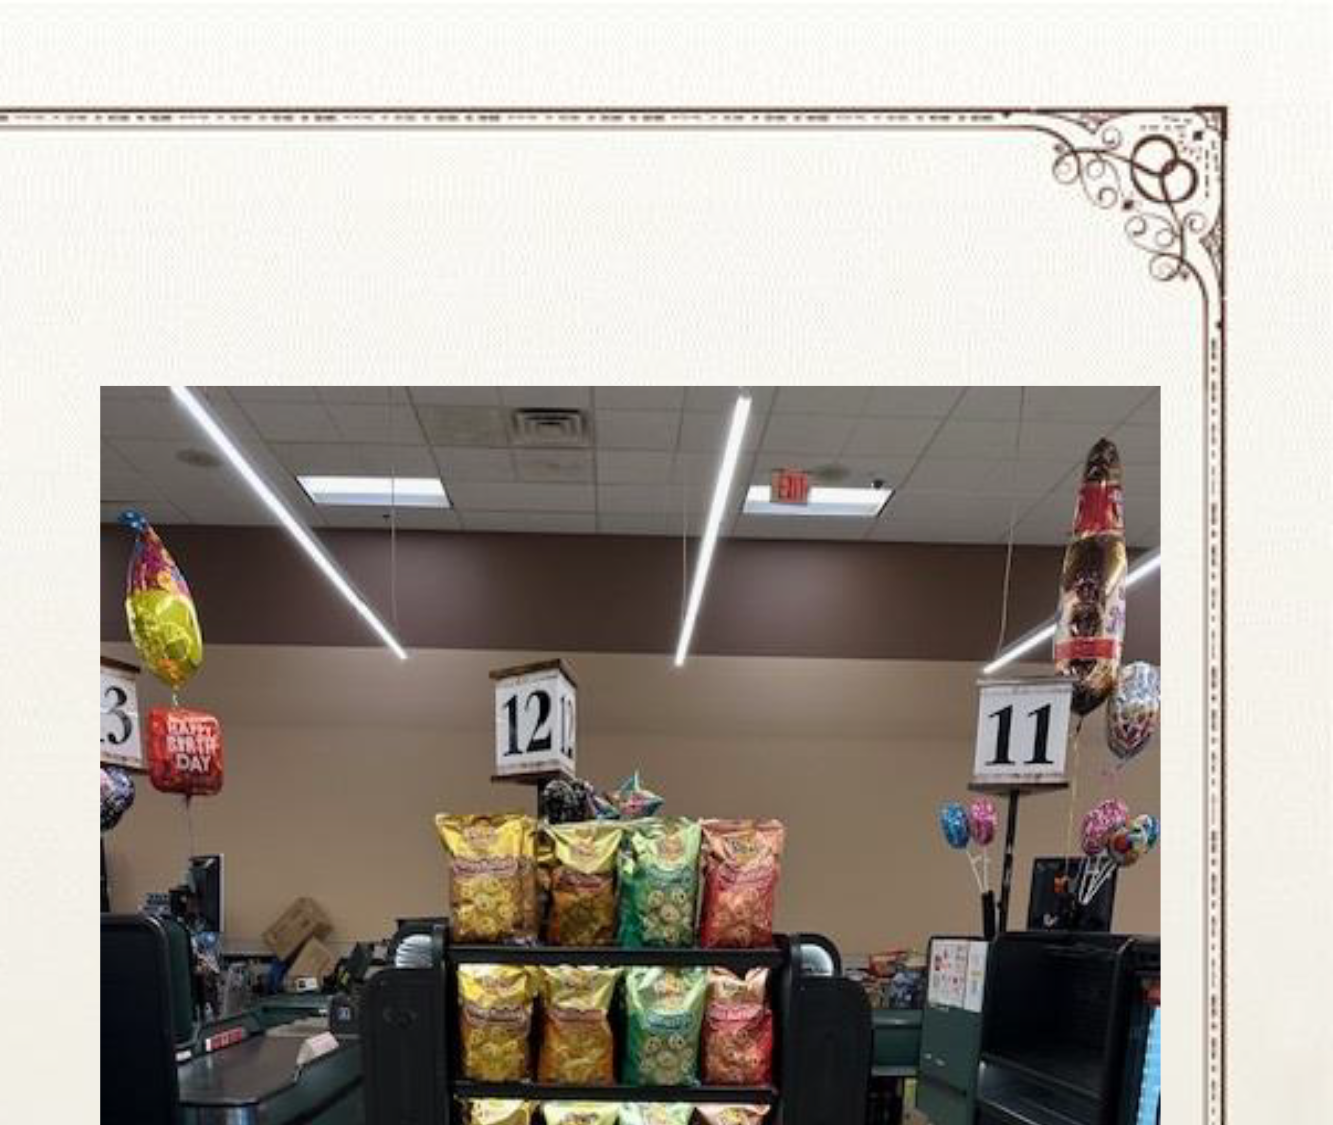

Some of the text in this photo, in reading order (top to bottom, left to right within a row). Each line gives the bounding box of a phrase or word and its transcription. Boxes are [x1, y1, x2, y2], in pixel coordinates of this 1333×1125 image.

[100, 686, 132, 745] 3
[167, 721, 214, 736] HAPPY
[502, 690, 552, 757] 12
[985, 704, 1054, 765] 11
[166, 736, 218, 753] BIRTH
[176, 753, 212, 772] DAY
